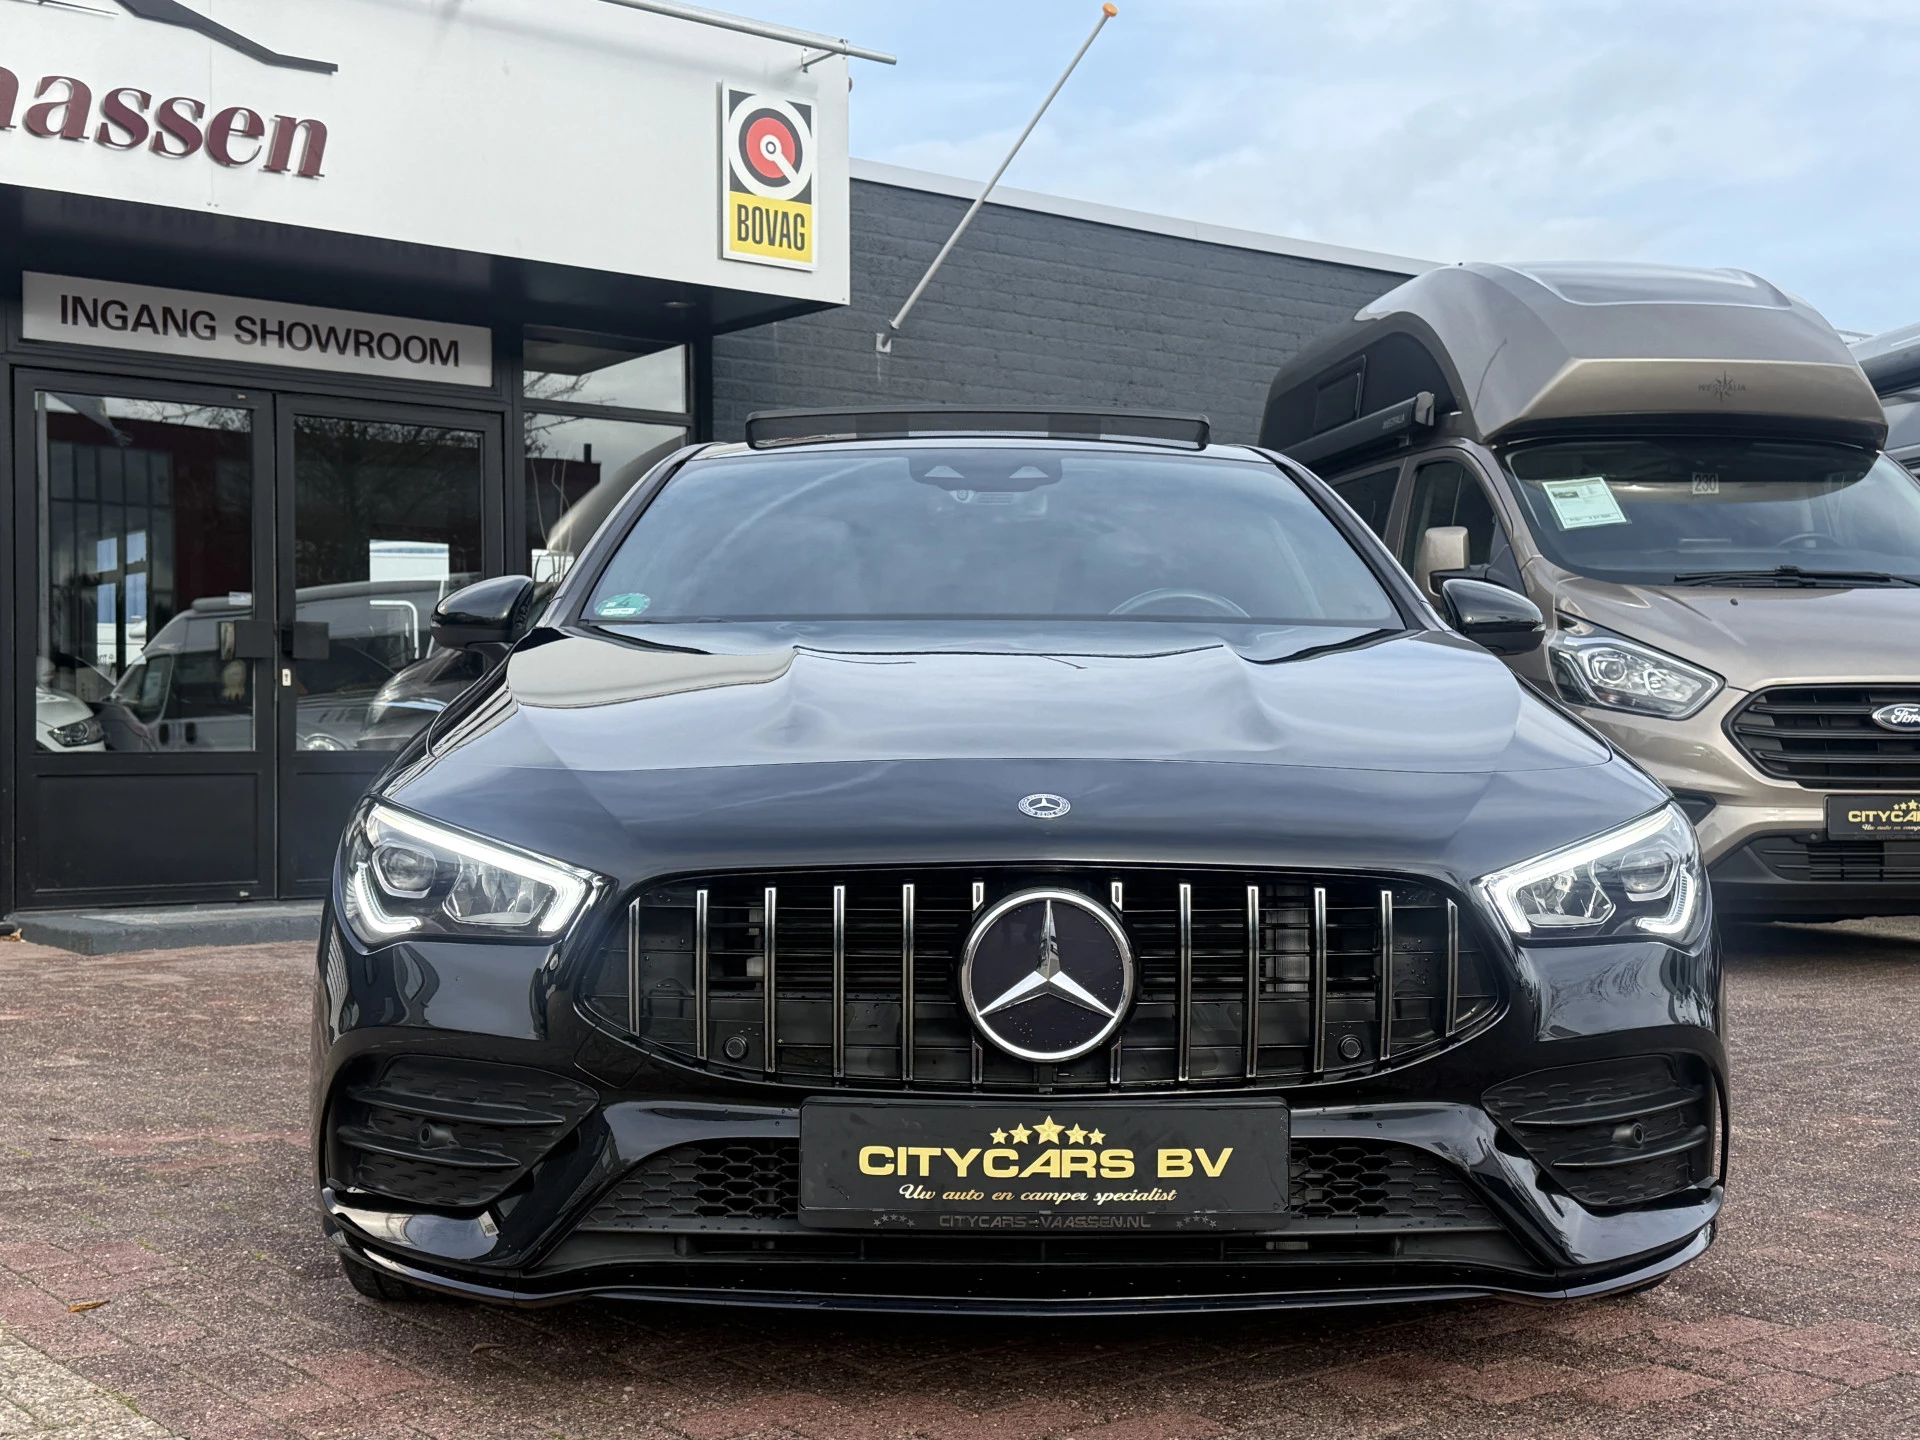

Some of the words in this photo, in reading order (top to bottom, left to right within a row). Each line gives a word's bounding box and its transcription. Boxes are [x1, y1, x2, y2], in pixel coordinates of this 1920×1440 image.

[737, 203, 806, 251] BOVAG
[60, 295, 217, 341] INGANG
[234, 315, 459, 367] SHOWROOM
[1694, 474, 1717, 492] 230
[617, 596, 632, 607] 4
[1848, 810, 1920, 822] CITYCA
[858, 1145, 1136, 1179] CITYCARS
[1157, 1147, 1234, 1178] BV
[899, 1183, 936, 1200] Uw
[942, 1189, 985, 1201] auto
[991, 1191, 1015, 1201] en
[1020, 1191, 1089, 1205] camper
[1093, 1187, 1178, 1206] specialist
